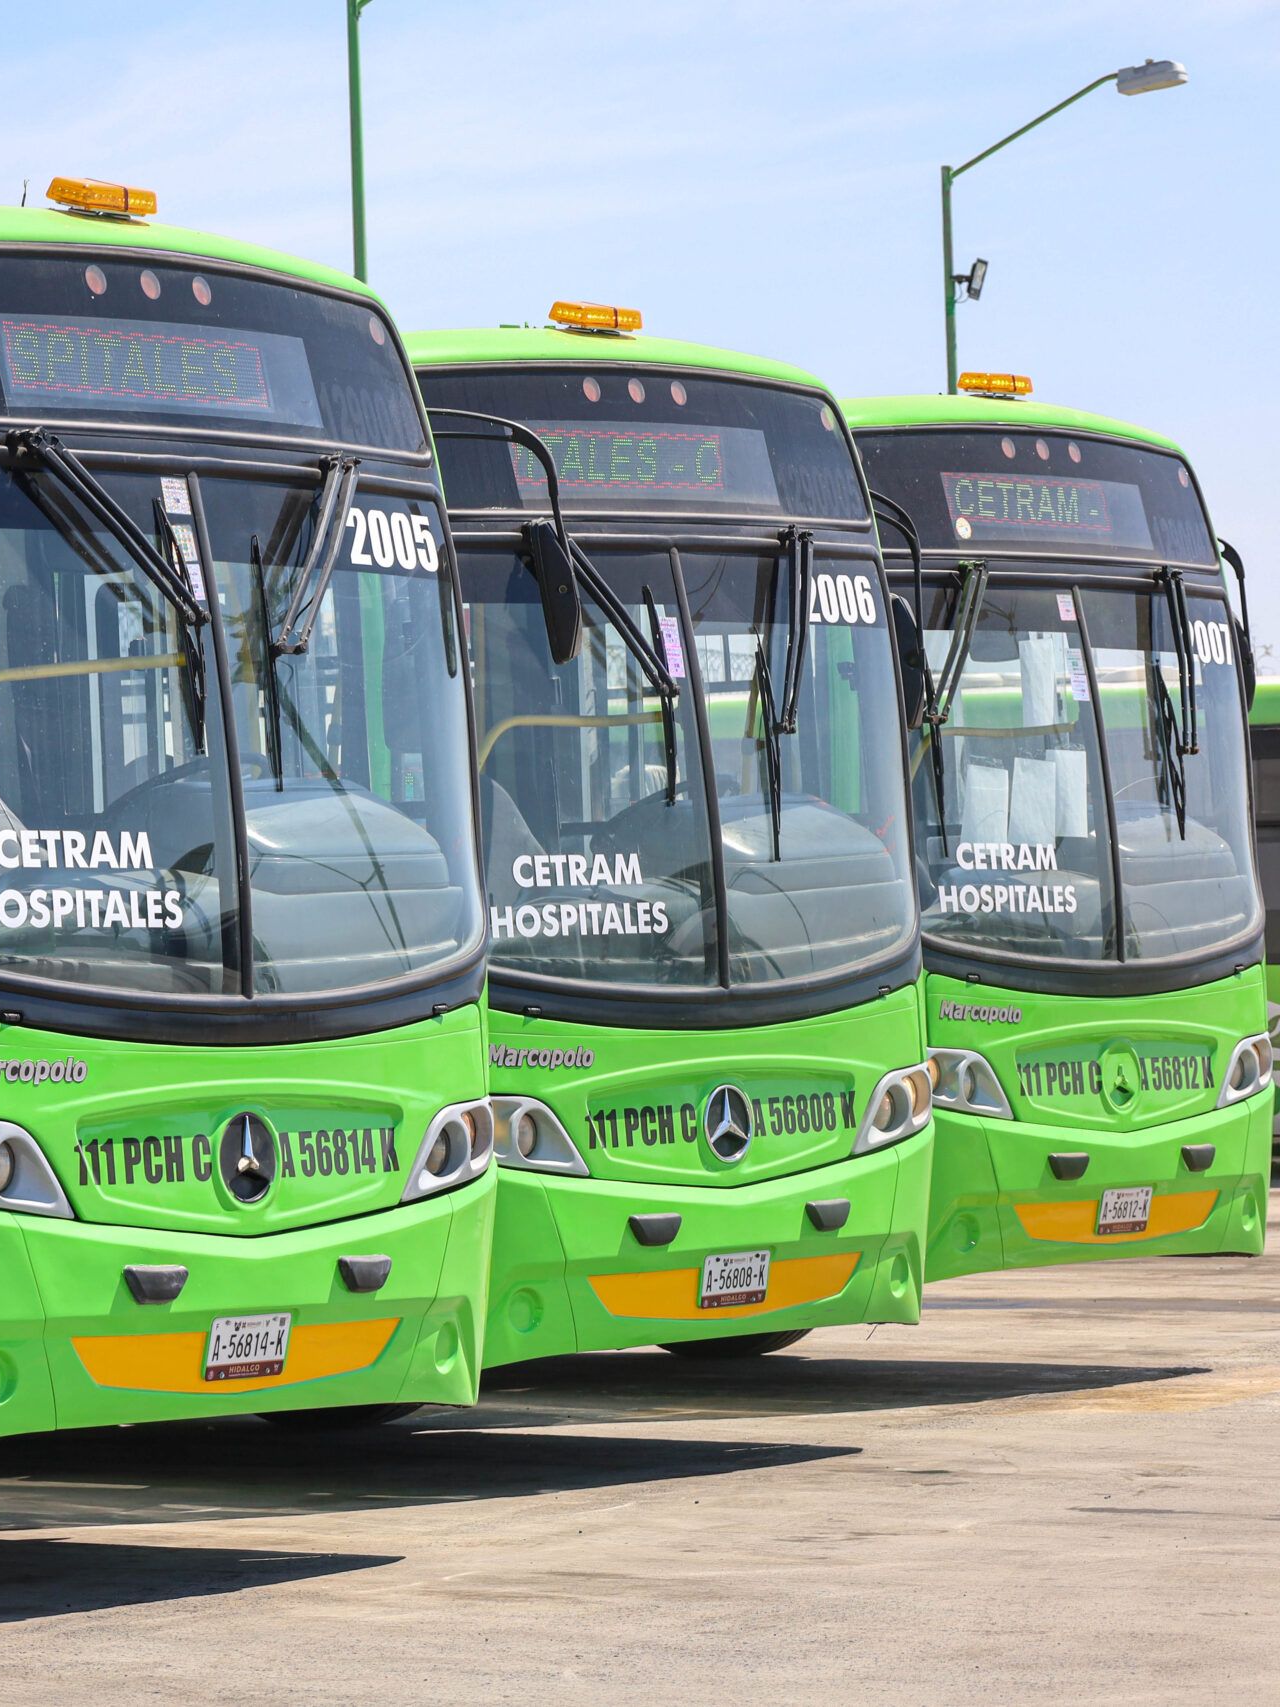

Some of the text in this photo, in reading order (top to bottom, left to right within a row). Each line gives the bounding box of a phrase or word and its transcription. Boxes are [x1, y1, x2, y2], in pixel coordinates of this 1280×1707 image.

[14, 331, 238, 397] SPITALES
[695, 441, 719, 483] C
[954, 479, 1079, 523] CETRAM
[346, 507, 438, 572] 2005
[512, 853, 643, 888] CETRAM
[955, 842, 1058, 872] CETRAM
[938, 884, 1078, 914] HOSPITALES
[490, 901, 669, 939] HOSPITALES
[939, 999, 1022, 1025] Marcopolo
[488, 1043, 595, 1071] Marcopolo
[1017, 1056, 1215, 1096] 111 PCH C A 56812 K
[585, 1090, 856, 1150] 111 PCH C A 56808 K
[74, 1127, 400, 1186] 111 PCH C A 56814 K
[1102, 1199, 1149, 1222] A-56812-K
[706, 1264, 766, 1293] A-56808-K
[212, 1329, 285, 1361] A-56814-K
[229, 1363, 260, 1374] HIDALGO
